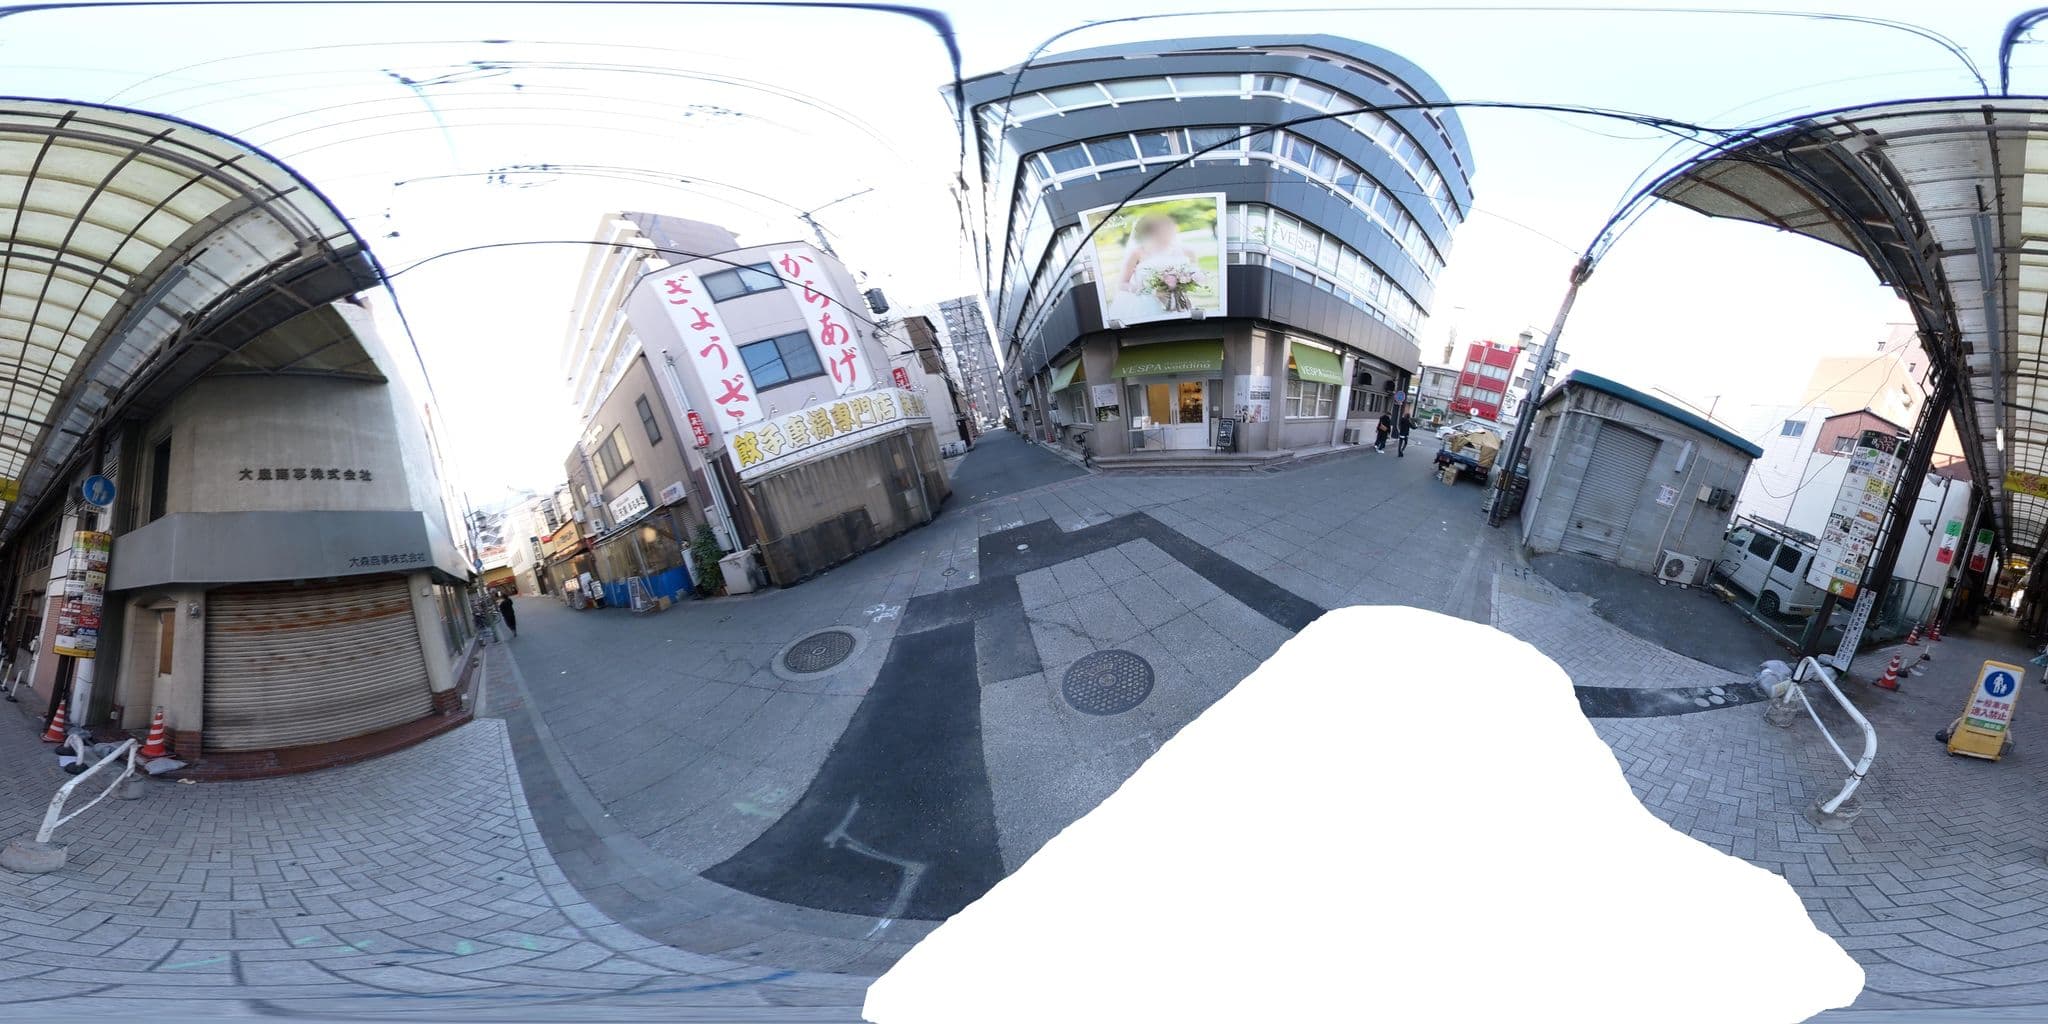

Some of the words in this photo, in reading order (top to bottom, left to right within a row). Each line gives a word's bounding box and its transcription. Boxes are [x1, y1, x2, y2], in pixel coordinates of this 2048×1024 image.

[779, 253, 857, 385] からあげ
[664, 275, 750, 418] ぎょうざ
[1121, 363, 1162, 375] VESPA
[238, 468, 373, 482] 大森商事株式会社
[348, 552, 426, 568] 大森商事株式会社
[1968, 706, 2007, 721] 進入禁止
